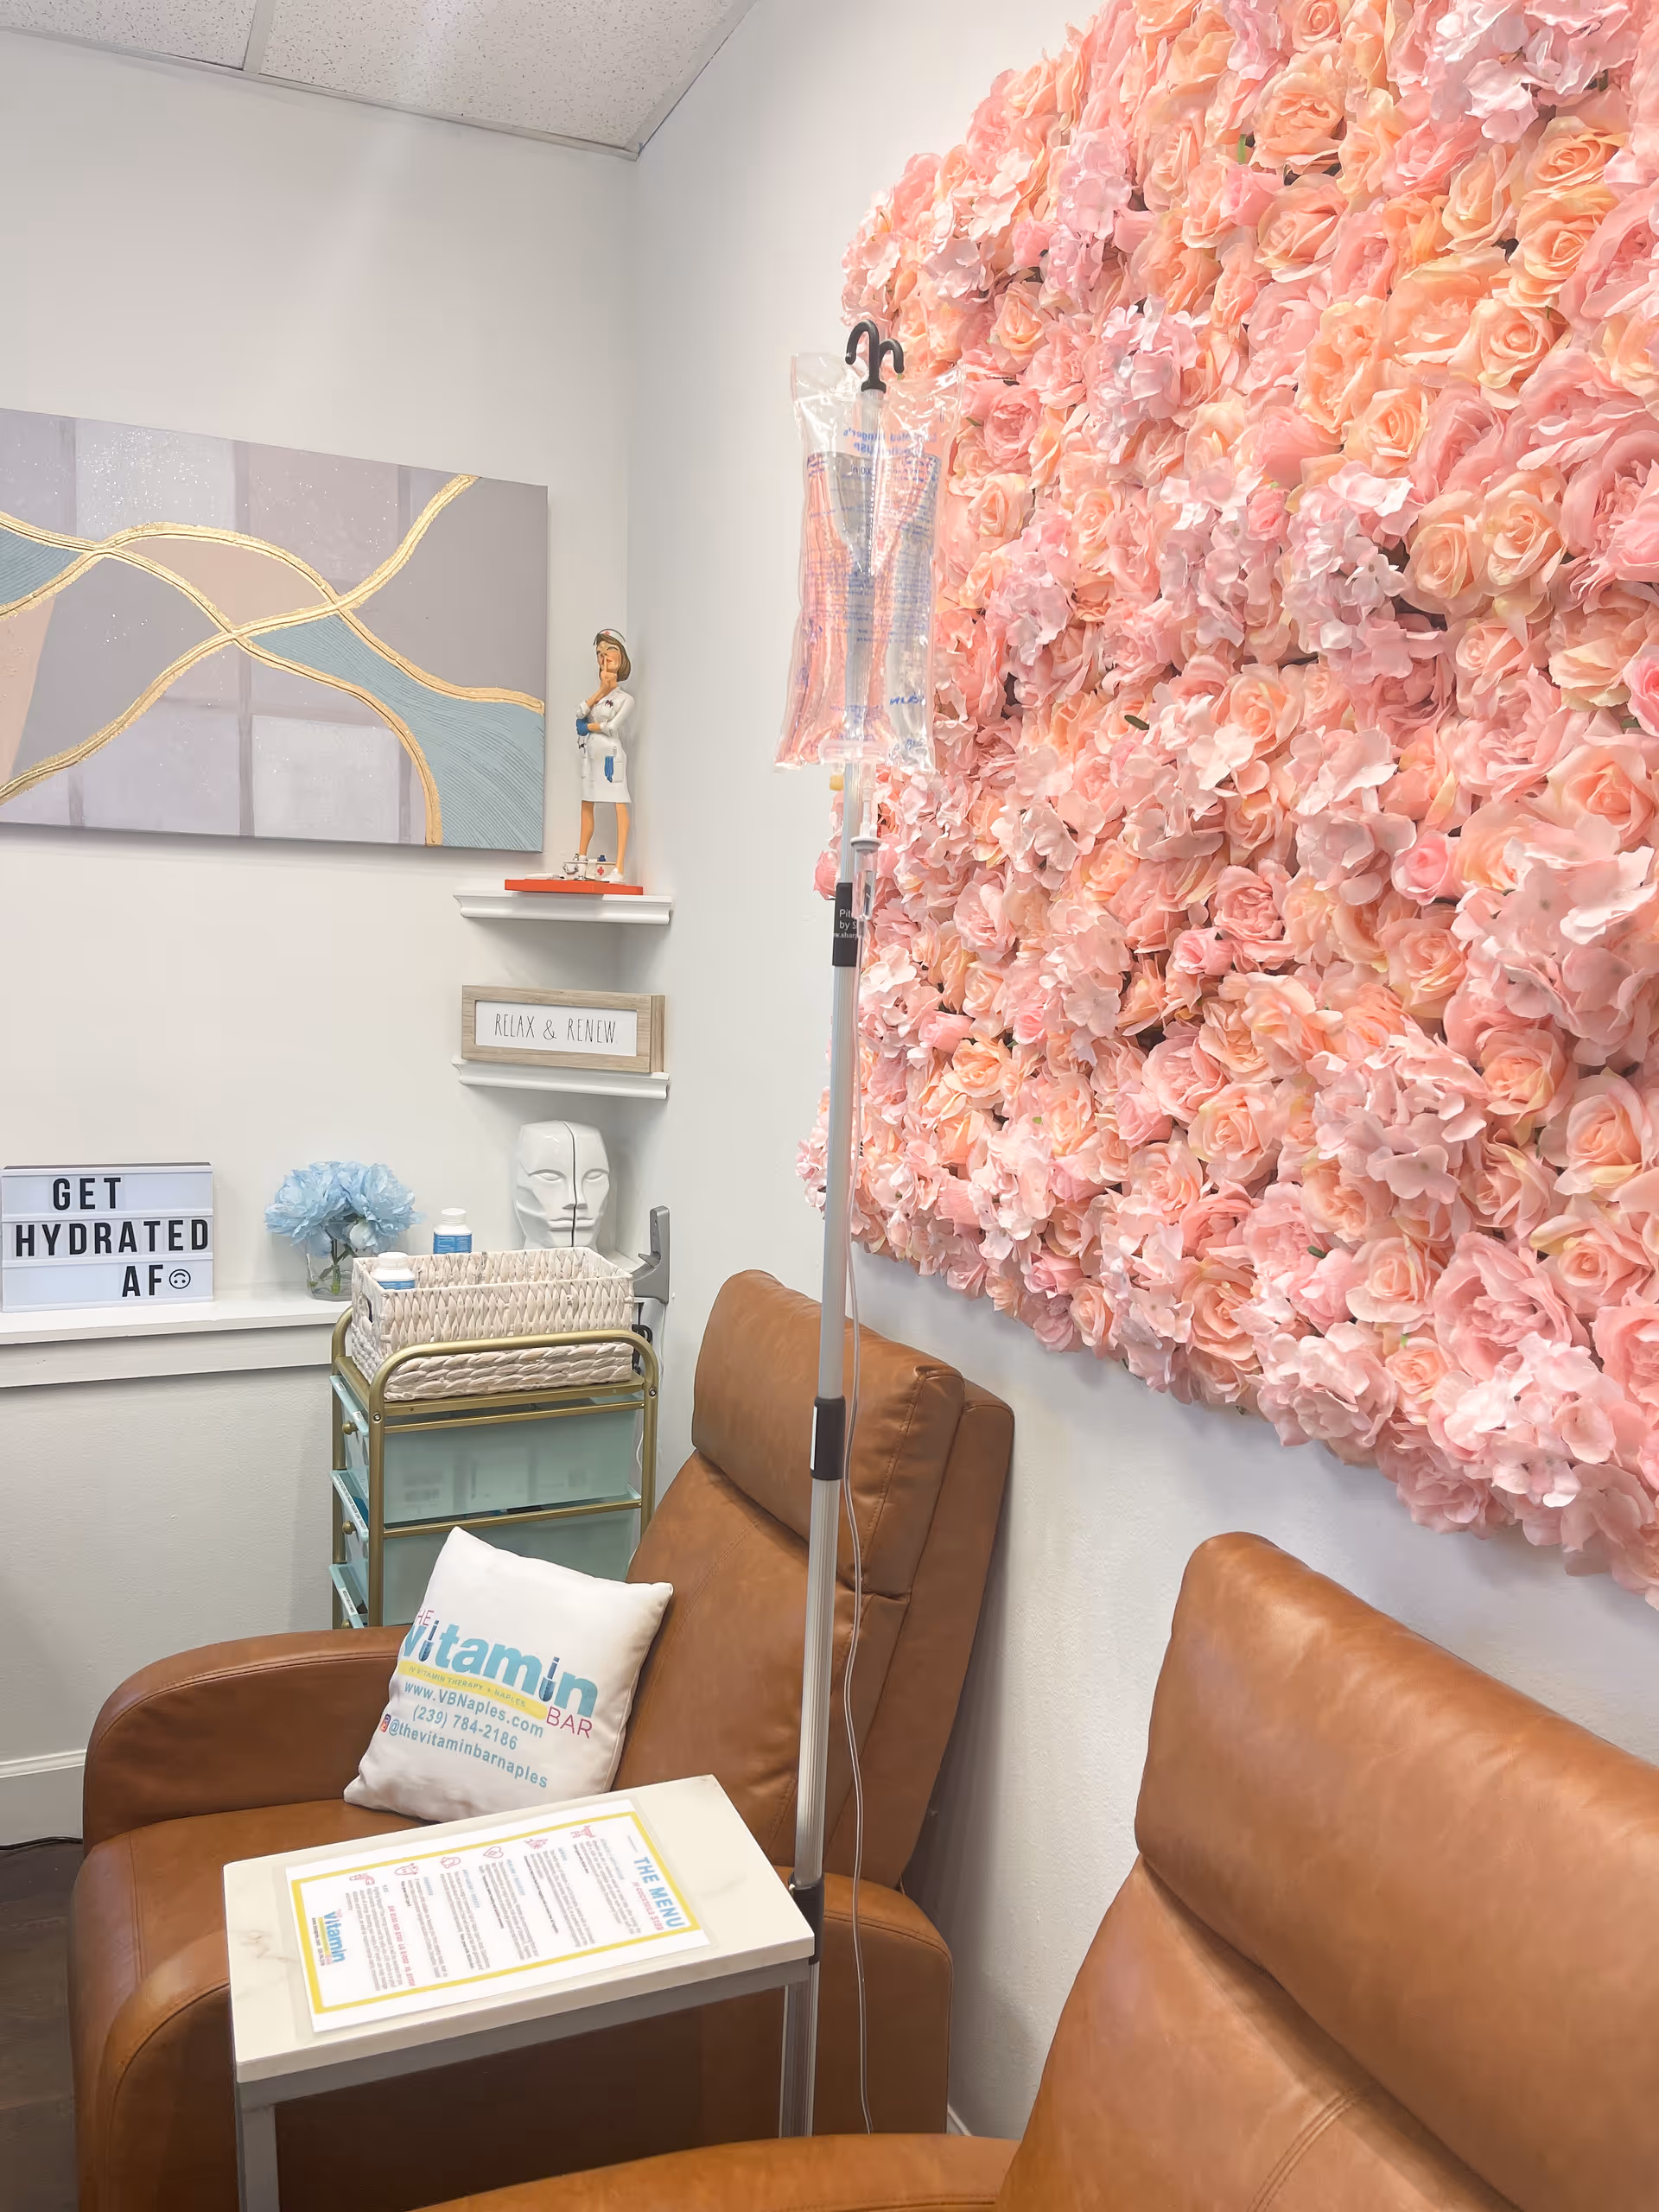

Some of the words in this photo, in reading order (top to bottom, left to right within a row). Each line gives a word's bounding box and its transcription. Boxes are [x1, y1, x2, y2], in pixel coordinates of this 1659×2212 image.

[839, 920, 850, 931] by
[494, 1013, 535, 1039] RELAX
[543, 1019, 557, 1040] &
[53, 1177, 122, 1211] GET
[16, 1219, 208, 1257] HYDRATED
[122, 1264, 164, 1297] AF
[403, 1619, 598, 1719] vitamin
[416, 1667, 446, 1683] VITAMIN
[448, 1677, 484, 1690] THERAPY
[493, 1688, 526, 1708] NAPLES
[404, 1681, 544, 1738] www.VBNaples.com
[412, 1704, 448, 1729] (239)
[453, 1713, 518, 1751] 784-2186
[546, 1706, 594, 1739] BAR
[388, 1718, 549, 1789] @thevitaminbarnaples
[633, 1856, 661, 1884] THE
[648, 1886, 686, 1928] MENU
[323, 1910, 347, 1963] vitamin
